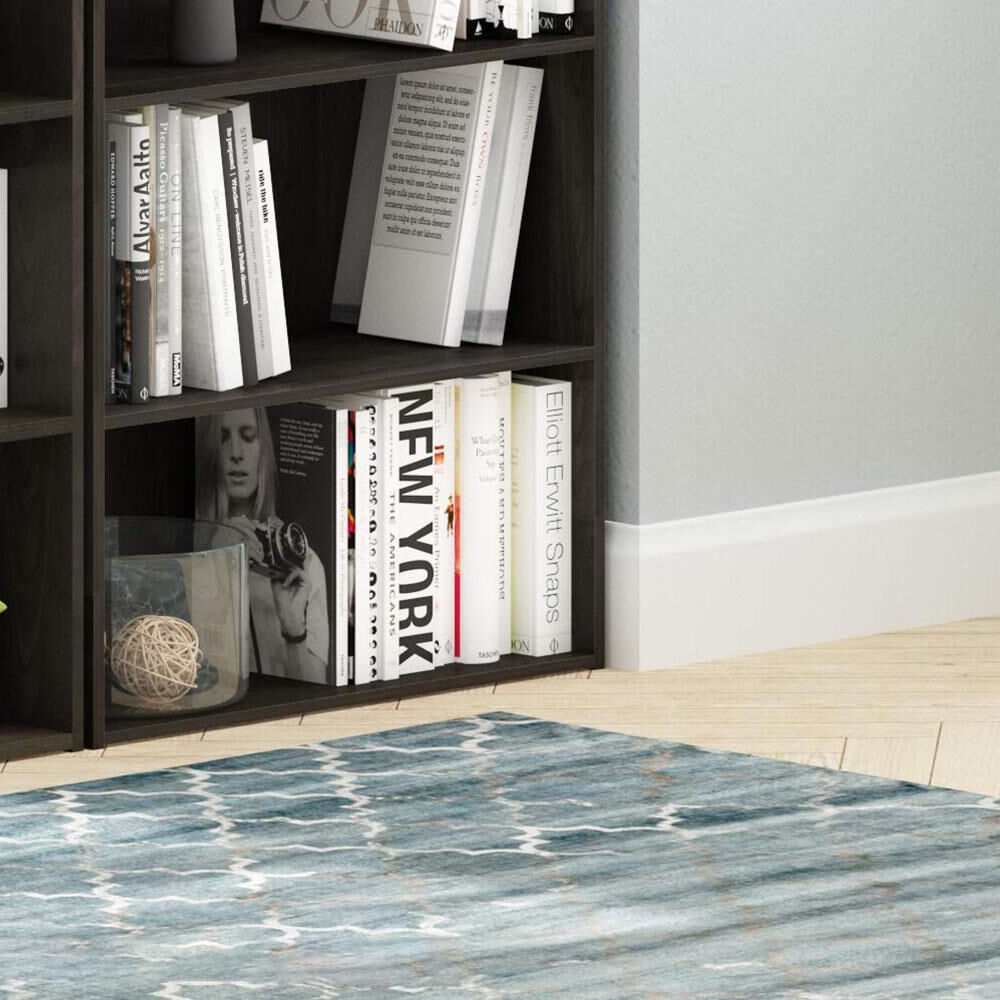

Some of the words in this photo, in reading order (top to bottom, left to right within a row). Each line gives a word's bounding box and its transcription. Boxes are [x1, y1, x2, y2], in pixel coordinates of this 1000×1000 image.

[374, 17, 423, 36] PHAIDON
[132, 139, 150, 196] Aalto
[159, 122, 168, 169] Picasso
[239, 127, 249, 164] STEVEN
[159, 172, 168, 222] Guitars
[243, 169, 253, 205] MEISEL
[257, 169, 266, 187] ride
[260, 188, 268, 203] the
[132, 198, 150, 254] Alvar
[173, 353, 181, 386] MoMA
[546, 391, 564, 457] Elliott
[546, 465, 564, 535] Erwitt
[399, 522, 434, 665] YORK
[542, 543, 564, 624] Snaps
